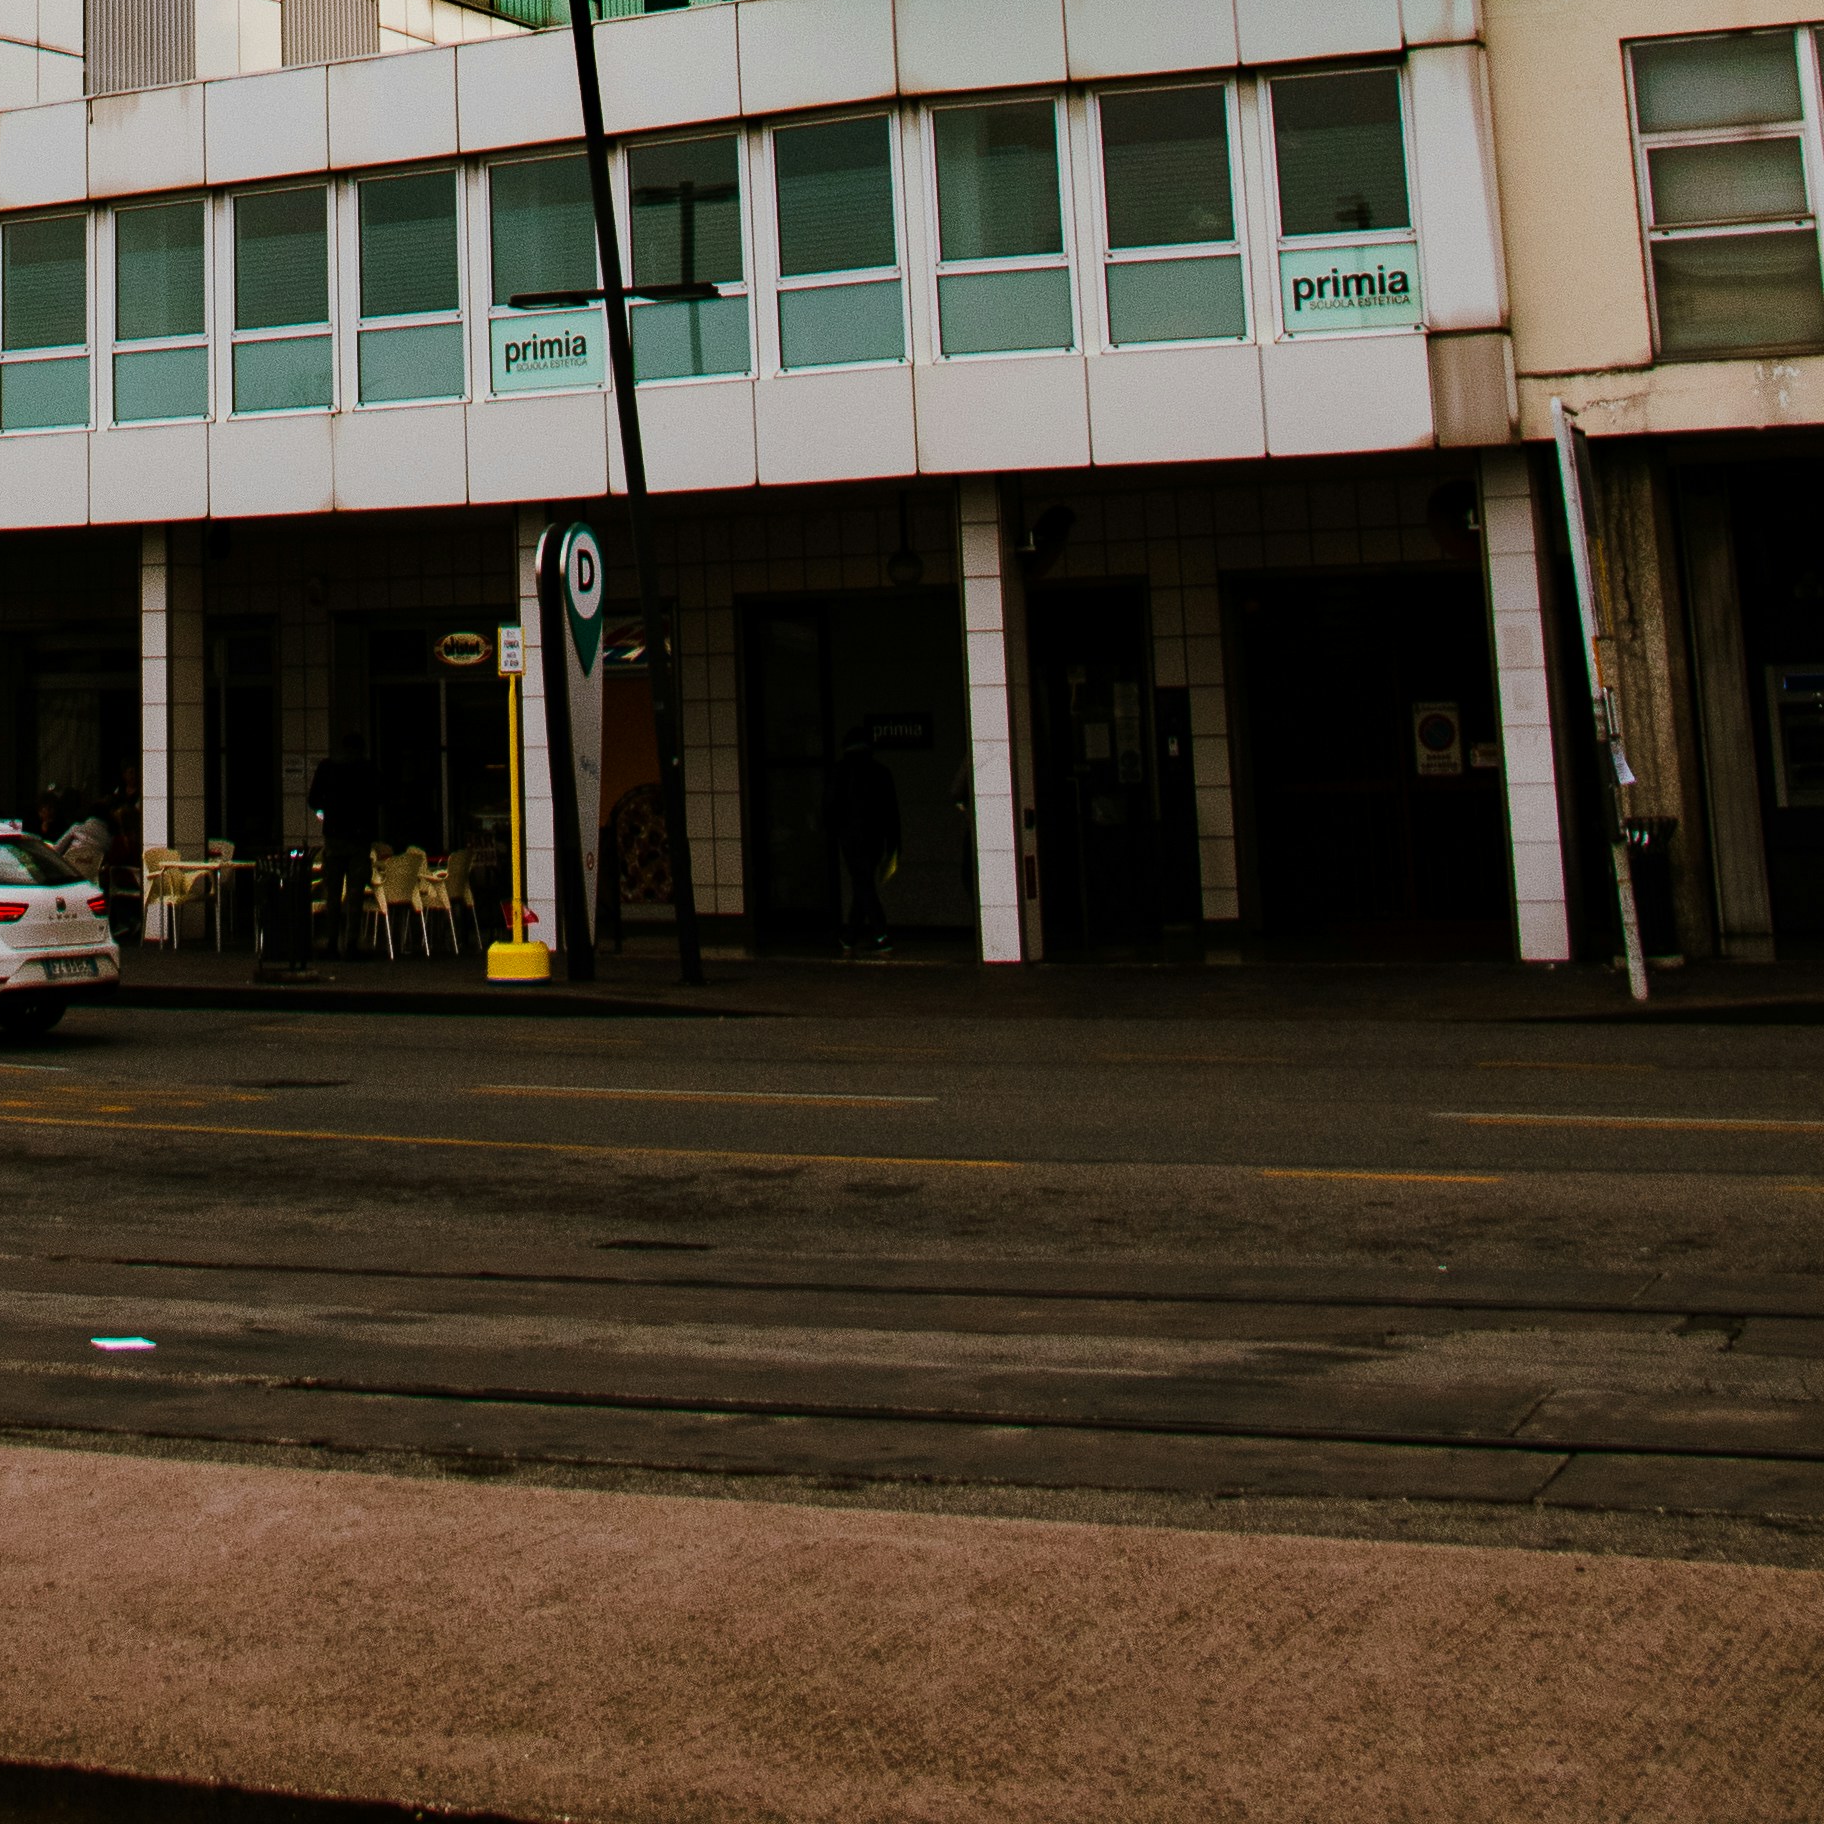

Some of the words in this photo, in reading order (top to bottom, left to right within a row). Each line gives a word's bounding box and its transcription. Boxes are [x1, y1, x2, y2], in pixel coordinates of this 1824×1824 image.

[1292, 264, 1410, 311] primia
[1309, 298, 1355, 310] SCUOLA
[1357, 295, 1411, 308] ESTETICA
[505, 330, 587, 373] primia
[516, 361, 548, 372] SCUOLA
[550, 357, 588, 369] ESTETICA
[578, 549, 595, 592] D
[873, 720, 922, 743] primia
